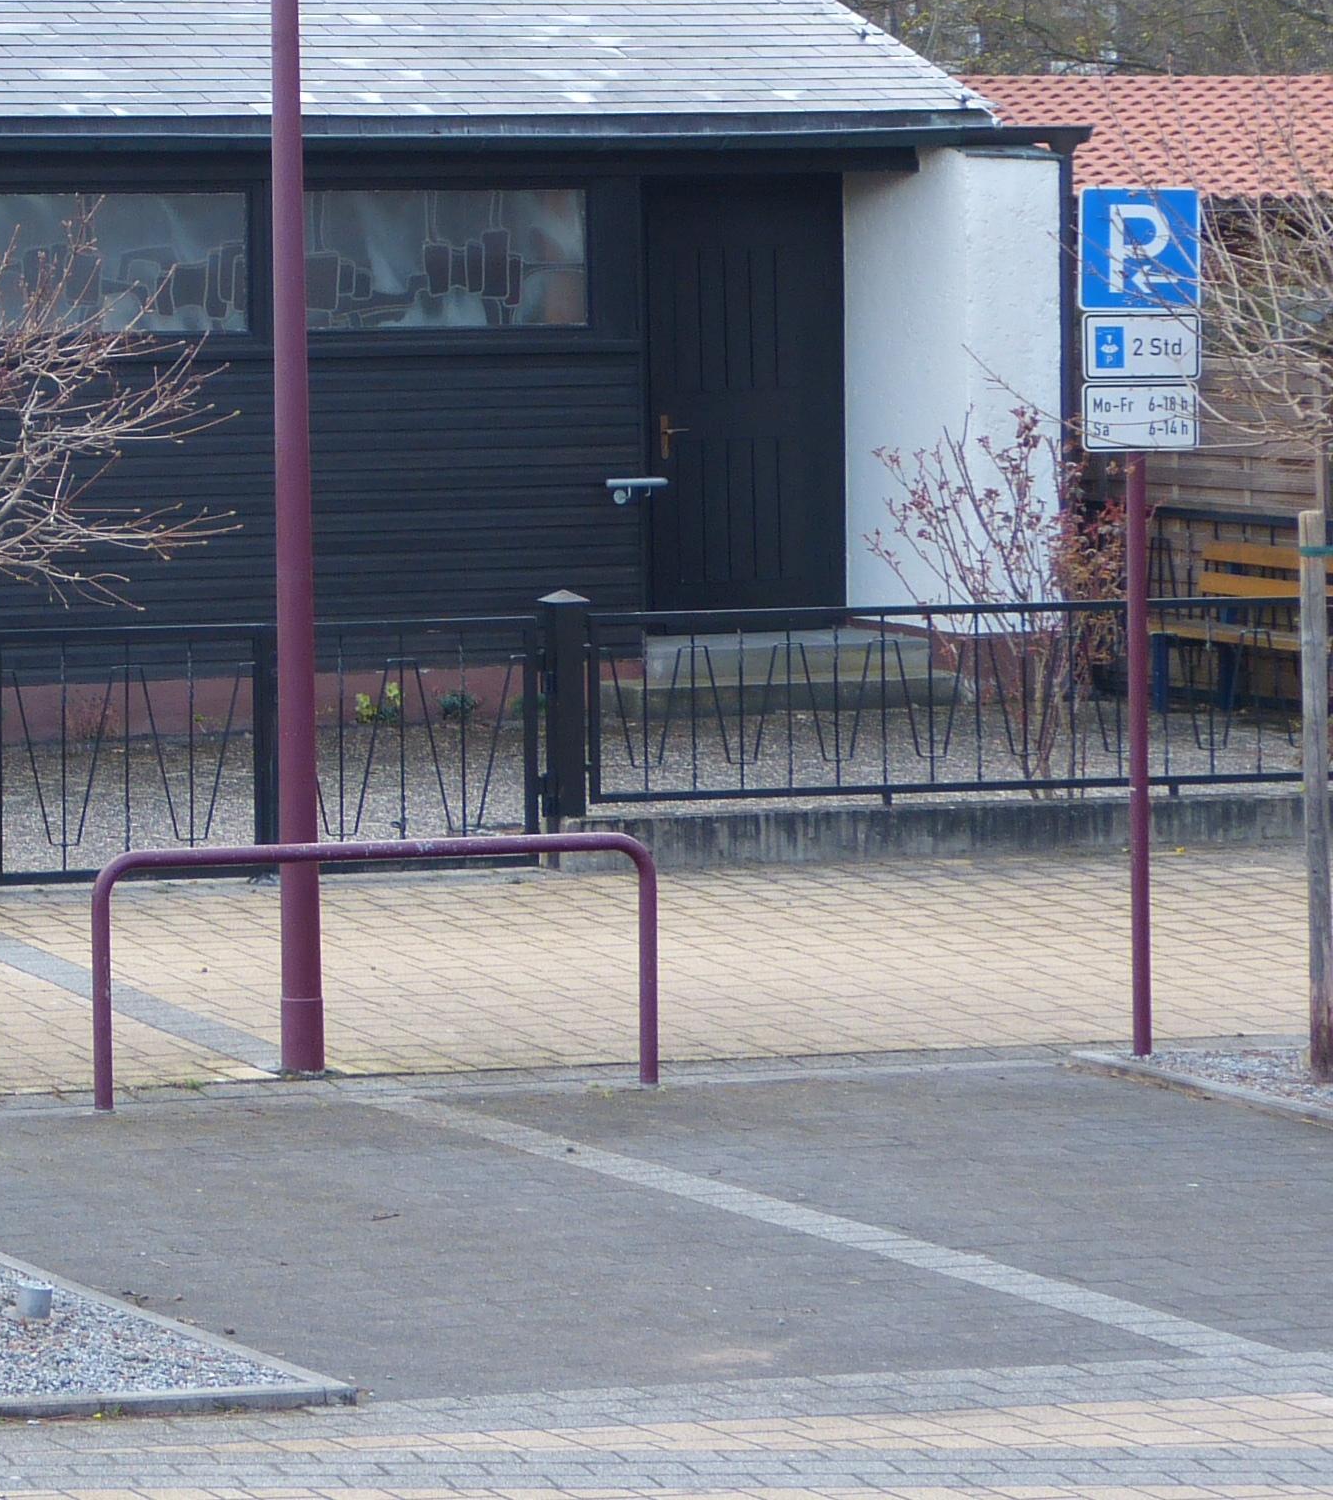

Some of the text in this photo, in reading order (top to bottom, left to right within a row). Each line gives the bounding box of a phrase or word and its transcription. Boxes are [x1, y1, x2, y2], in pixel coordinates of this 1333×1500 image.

[1109, 204, 1170, 293] P
[1133, 337, 1182, 356] 2 Std
[1093, 395, 1188, 413] Mo-Fr 6-18 h
[1093, 419, 1188, 436] Sa 6-14 h
